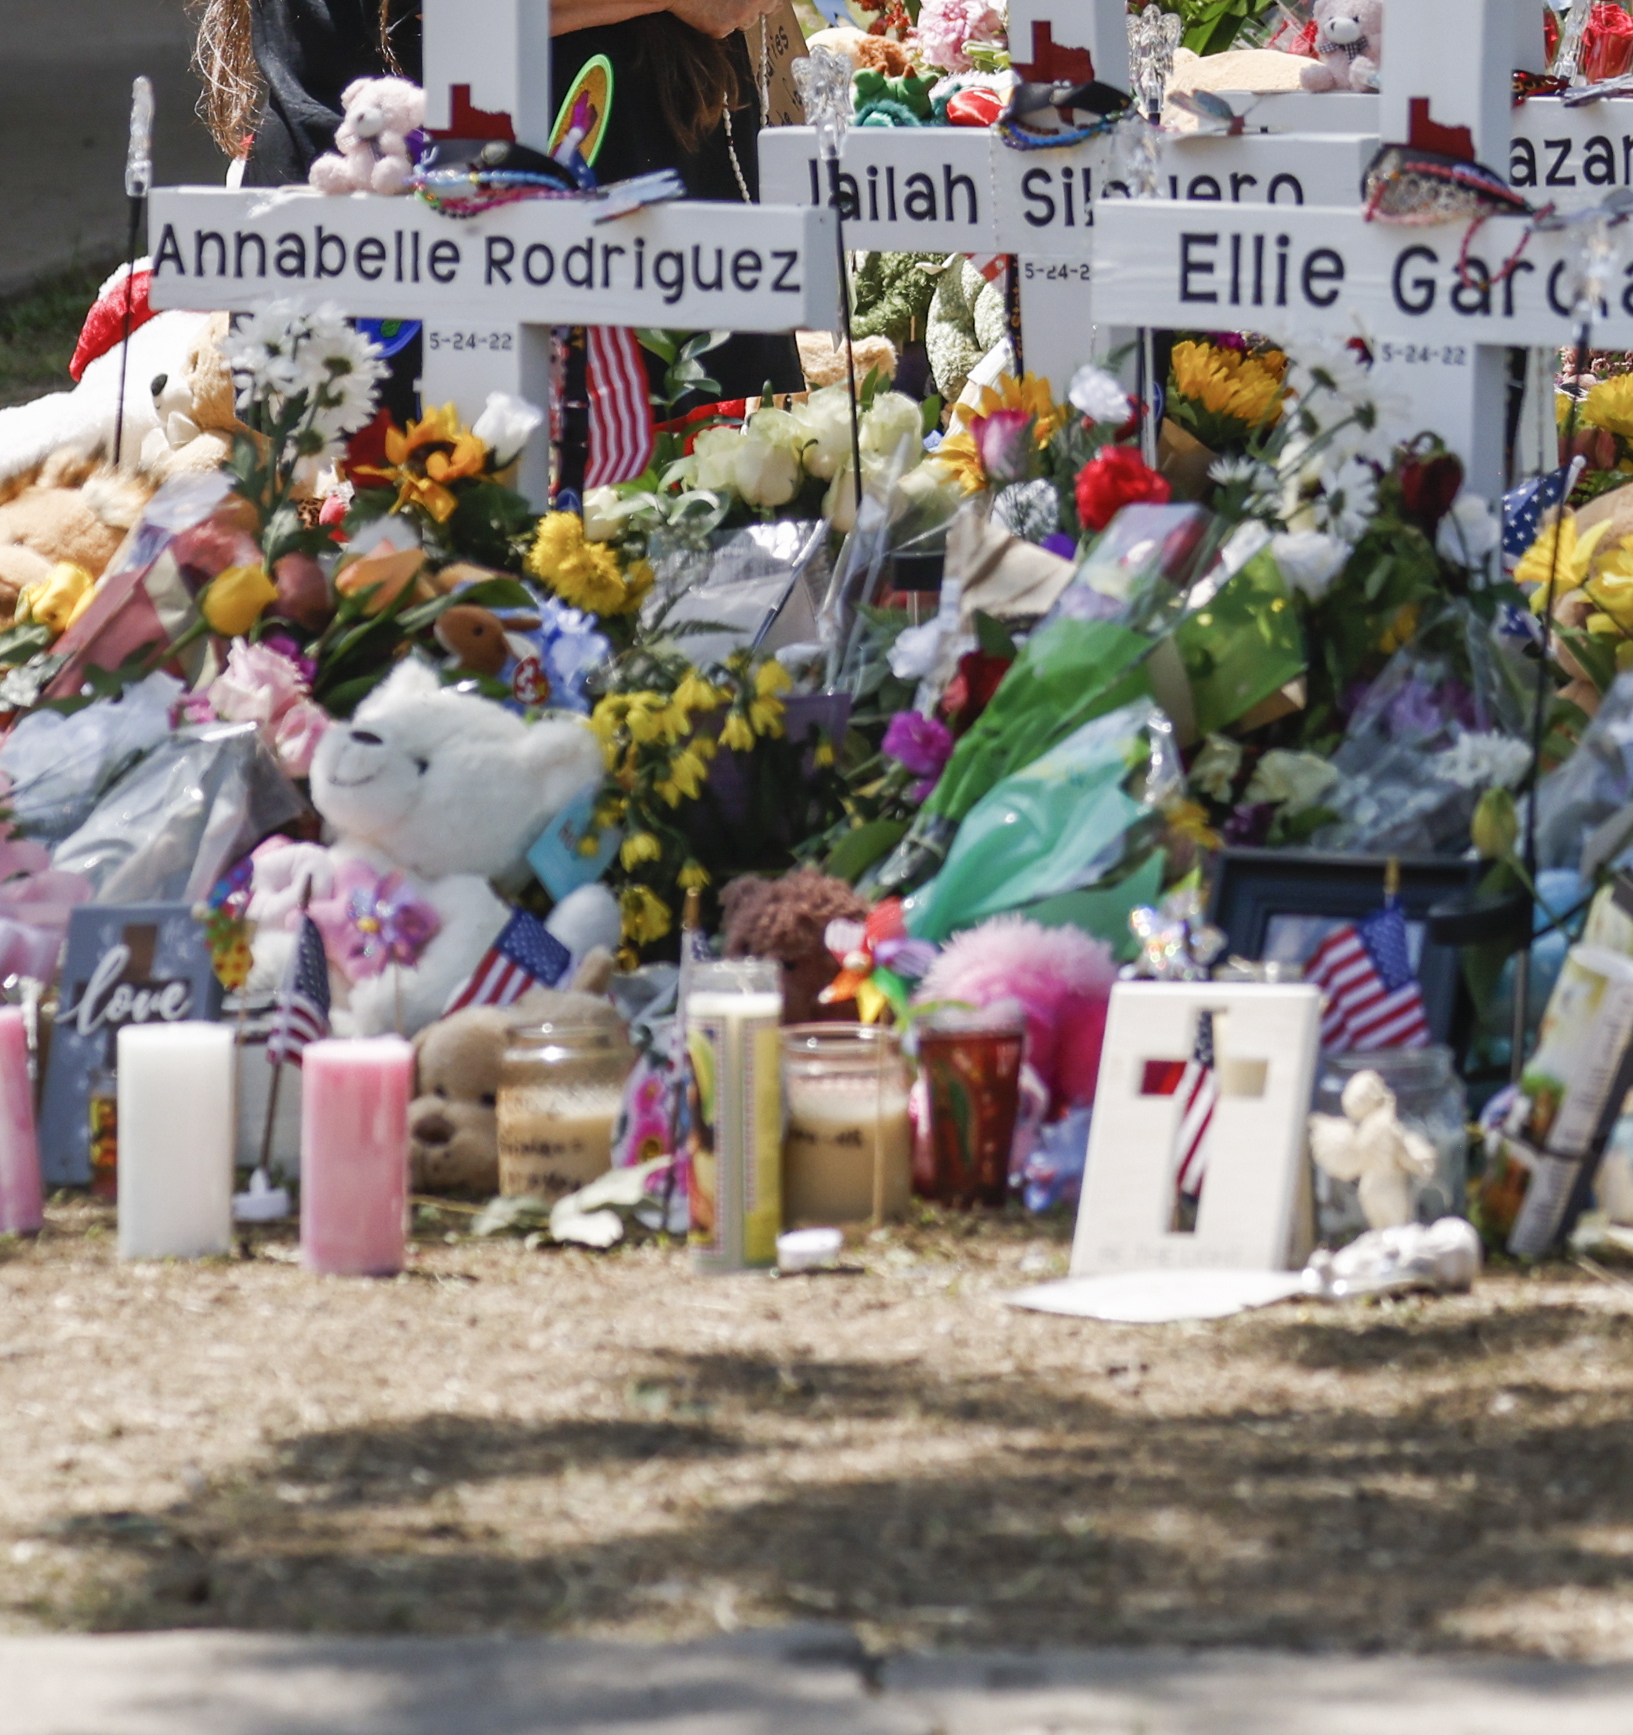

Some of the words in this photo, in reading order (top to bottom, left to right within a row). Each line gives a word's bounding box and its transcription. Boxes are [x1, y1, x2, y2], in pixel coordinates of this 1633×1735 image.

[152, 222, 460, 283] Annabelle
[484, 235, 801, 305] Rodriguez
[1025, 261, 1091, 281] 5-24-2
[1179, 232, 1346, 308] Ellie
[429, 331, 513, 351] 5-24-22
[1381, 345, 1467, 366] 5-24-22
[53, 944, 193, 1036] love
